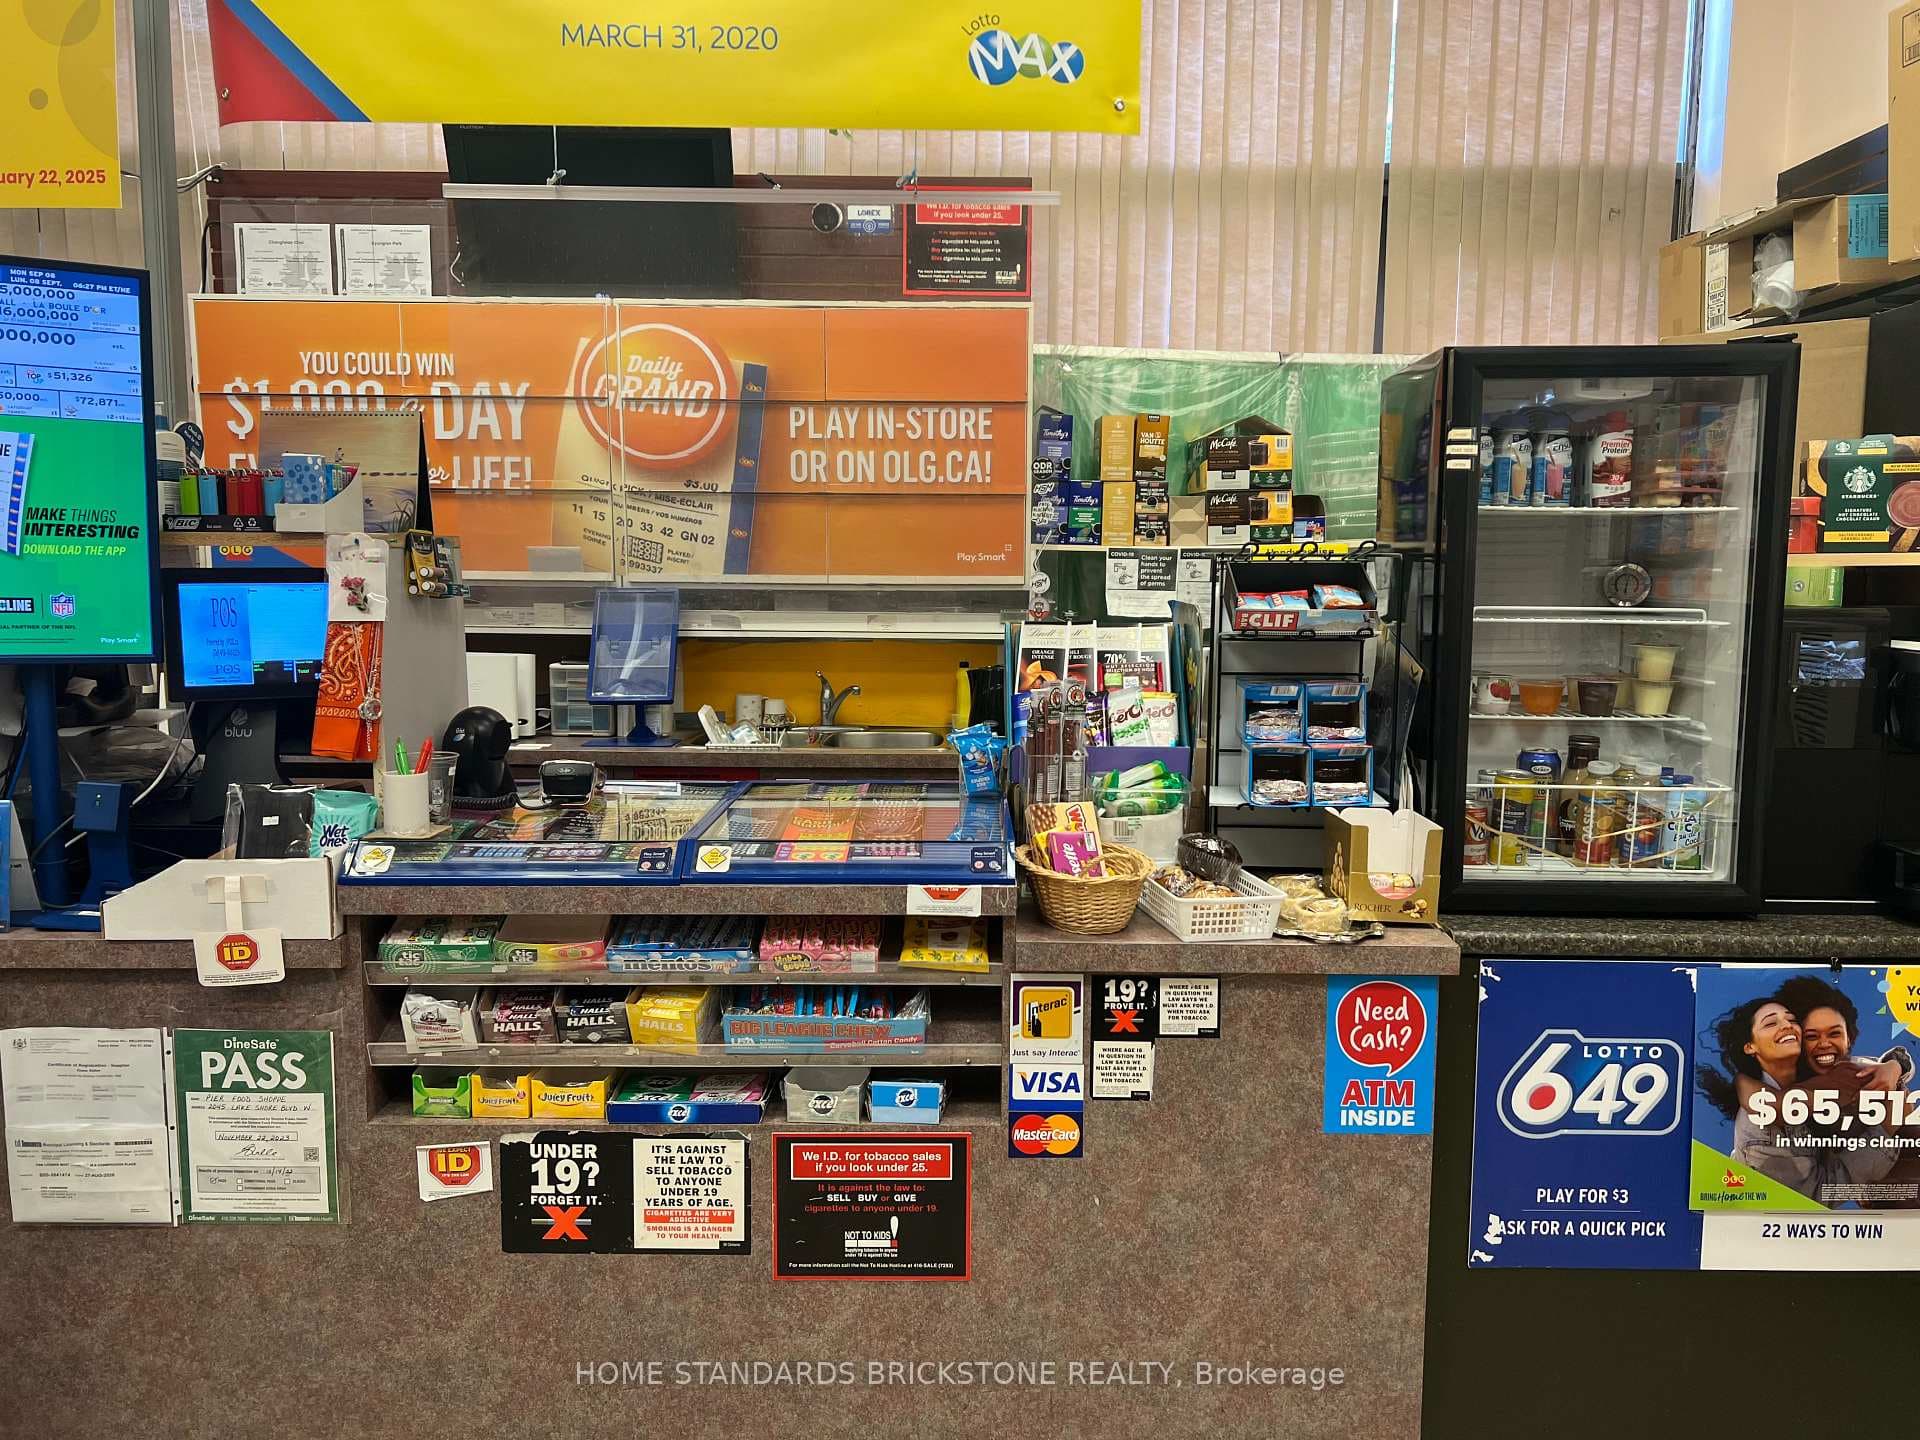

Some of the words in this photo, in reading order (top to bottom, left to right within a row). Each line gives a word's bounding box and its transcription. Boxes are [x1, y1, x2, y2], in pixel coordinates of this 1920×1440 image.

[961, 13, 1001, 36] Lotto
[561, 23, 662, 50] MARCH
[671, 25, 704, 54] 31,
[710, 25, 778, 51] 2020
[968, 29, 1083, 86] MAX
[39, 169, 62, 187] 22,
[65, 169, 106, 184] 2025
[857, 209, 881, 217] LOREX
[300, 352, 340, 375] YOU
[344, 352, 411, 376] COULD
[415, 353, 455, 376] WIN
[626, 354, 685, 382] Daily
[48, 371, 93, 382] $51,326
[593, 374, 714, 419] GRAND
[430, 381, 530, 441] DAY
[789, 406, 860, 440] PLAY
[867, 407, 993, 440] IN-STORE
[1043, 428, 1069, 440] Timothy's
[1209, 438, 1237, 450] McCafé
[790, 450, 829, 483] OR
[836, 450, 875, 483] ON
[883, 450, 991, 483] OLG.CA!
[1032, 461, 1053, 470] ODR
[452, 455, 533, 496] LIFE!
[26, 507, 67, 521] MAKE
[70, 508, 117, 523] THINGS
[175, 519, 200, 527] BIC
[24, 522, 140, 539] INTERESTING
[640, 522, 654, 533] 33
[660, 527, 674, 538] 42
[23, 543, 82, 555] DOWNLOAD
[84, 545, 104, 556] THE
[105, 546, 126, 557] APP
[219, 545, 253, 556] OLG
[211, 597, 238, 628] POS
[1249, 613, 1295, 629] CLIF
[224, 726, 252, 738] bluu
[322, 823, 350, 839] Wet
[319, 835, 348, 848] Ones
[1353, 902, 1393, 914] ROCHER
[398, 958, 421, 968] tac
[401, 950, 421, 960] tic
[623, 955, 713, 972] mentos
[1354, 996, 1410, 1024] Need
[567, 1015, 617, 1027] HALLS.
[730, 1022, 761, 1035] BIG
[764, 1022, 833, 1037] LEAGUE
[835, 1023, 891, 1038] CHEW
[1350, 1024, 1412, 1052] Cash?
[224, 1037, 277, 1049] DineSafe
[1011, 1049, 1030, 1057] Just
[1032, 1050, 1047, 1058] say
[1048, 1049, 1079, 1057] Interac
[1583, 1045, 1663, 1059] LOTTO
[201, 1051, 307, 1090] PASS
[1017, 1071, 1081, 1094] VISA
[1511, 1043, 1669, 1126] 649
[538, 1092, 566, 1103] Juicy
[566, 1092, 592, 1103] Fruit
[808, 1093, 837, 1110] excel
[1340, 1079, 1416, 1108] ATM
[1340, 1109, 1416, 1126] INSIDE
[1013, 1128, 1080, 1141] MasterCard
[530, 1143, 598, 1159] UNDER
[651, 1145, 672, 1154] IT'S
[676, 1145, 727, 1154] AGAINST
[1776, 1135, 1790, 1148] in
[1793, 1134, 1867, 1152] winnings
[437, 1153, 472, 1172] ID
[654, 1156, 676, 1164] THE
[680, 1156, 705, 1164] LAW
[709, 1156, 723, 1164] TO
[802, 1152, 820, 1161] We
[823, 1152, 842, 1161] I.D.
[845, 1152, 861, 1161] for
[864, 1152, 909, 1161] tobacco
[912, 1152, 942, 1161] sales
[531, 1158, 600, 1195] 19?
[646, 1166, 674, 1175] SELL
[678, 1166, 732, 1175] TOBACCO
[815, 1163, 823, 1172] if
[826, 1164, 846, 1174] you
[849, 1163, 873, 1172] look
[876, 1163, 909, 1172] under
[911, 1163, 928, 1172] 25.
[655, 1177, 670, 1185] TO
[674, 1177, 722, 1185] ANYONE
[839, 1184, 873, 1193] against
[660, 1188, 699, 1196] UNDER
[703, 1188, 718, 1196] 19
[827, 1194, 851, 1202] SELL
[858, 1194, 877, 1202] BUY
[893, 1194, 917, 1202] GIVE
[1536, 1188, 1574, 1204] PLAY
[1578, 1189, 1608, 1204] FOR
[1612, 1189, 1629, 1204] $3
[530, 1195, 582, 1206] FORGET
[586, 1196, 602, 1206] IT.
[645, 1198, 683, 1207] YEARS
[687, 1198, 703, 1207] OF
[706, 1198, 733, 1207] AGE.
[804, 1204, 849, 1213] cigarettes
[851, 1204, 861, 1212] to
[863, 1205, 895, 1213] anyone
[898, 1204, 923, 1212] under
[926, 1204, 938, 1212] 19.
[845, 1231, 861, 1240] NOT
[862, 1231, 872, 1240] TO
[1498, 1220, 1526, 1235] ASK
[1531, 1220, 1560, 1235] FOR
[1564, 1221, 1575, 1236] A
[1579, 1221, 1626, 1236] QUICK
[1631, 1221, 1666, 1237] PICK
[1762, 1223, 1780, 1238] 22
[1787, 1224, 1826, 1239] WAYS
[1831, 1224, 1850, 1239] TO
[1855, 1224, 1883, 1239] WIN
